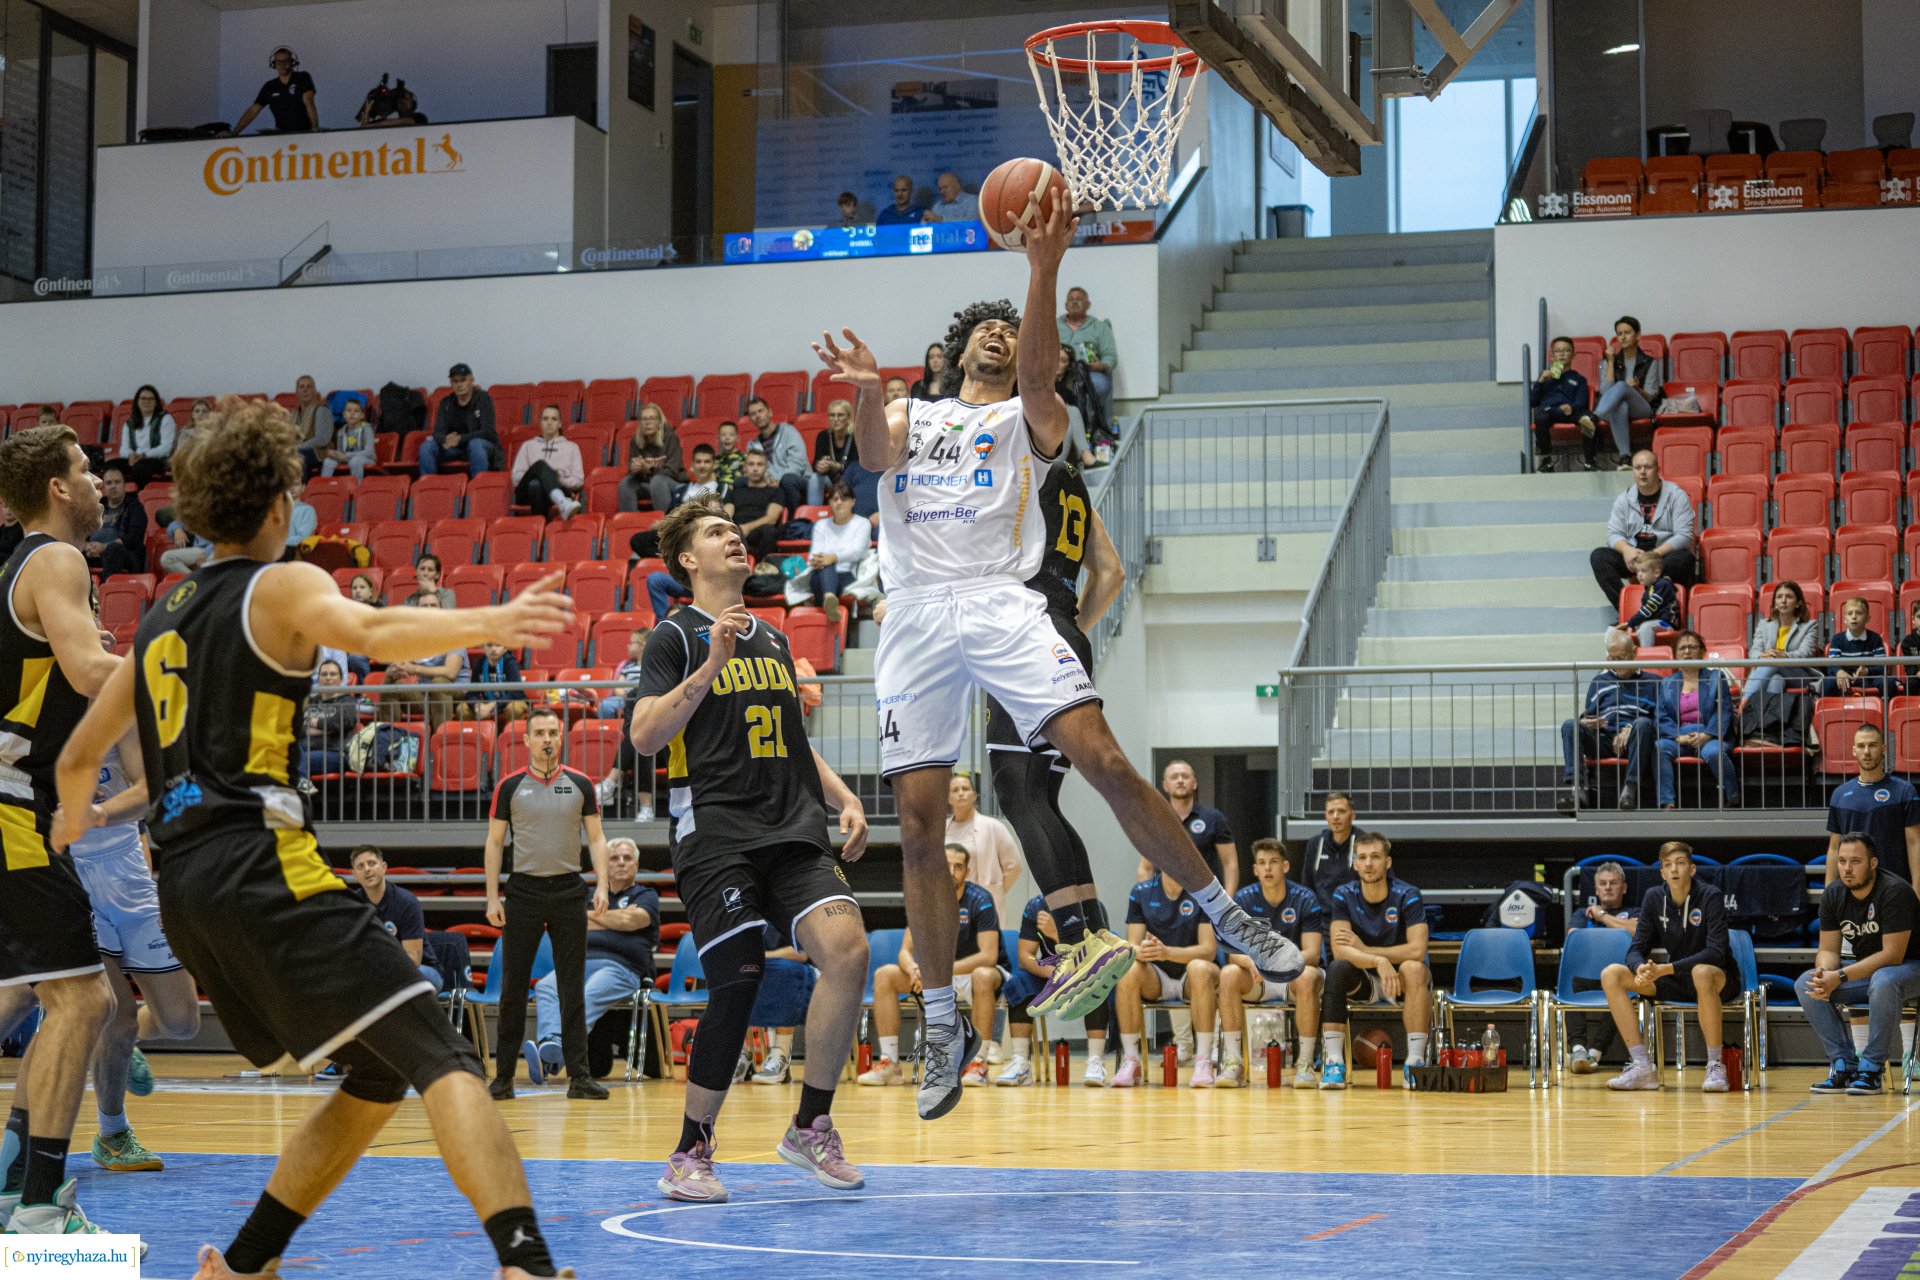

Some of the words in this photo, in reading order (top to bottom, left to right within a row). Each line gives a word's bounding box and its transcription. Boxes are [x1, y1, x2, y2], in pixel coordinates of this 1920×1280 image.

[203, 137, 426, 196] Continental
[1573, 192, 1632, 206] Eissmann
[1744, 184, 1803, 198] Eissmann
[1573, 206, 1595, 214] Group
[1597, 205, 1632, 213] Automotive
[1744, 199, 1765, 207] Group
[1767, 198, 1803, 206] Automotive
[580, 246, 664, 266] Continental
[914, 419, 932, 427] AKO
[928, 435, 962, 465] 44
[911, 474, 968, 487] HÜBNER
[905, 507, 979, 523] Selyem-Ber
[1055, 488, 1087, 562] 13
[143, 630, 189, 749] 6
[745, 705, 788, 759] 21
